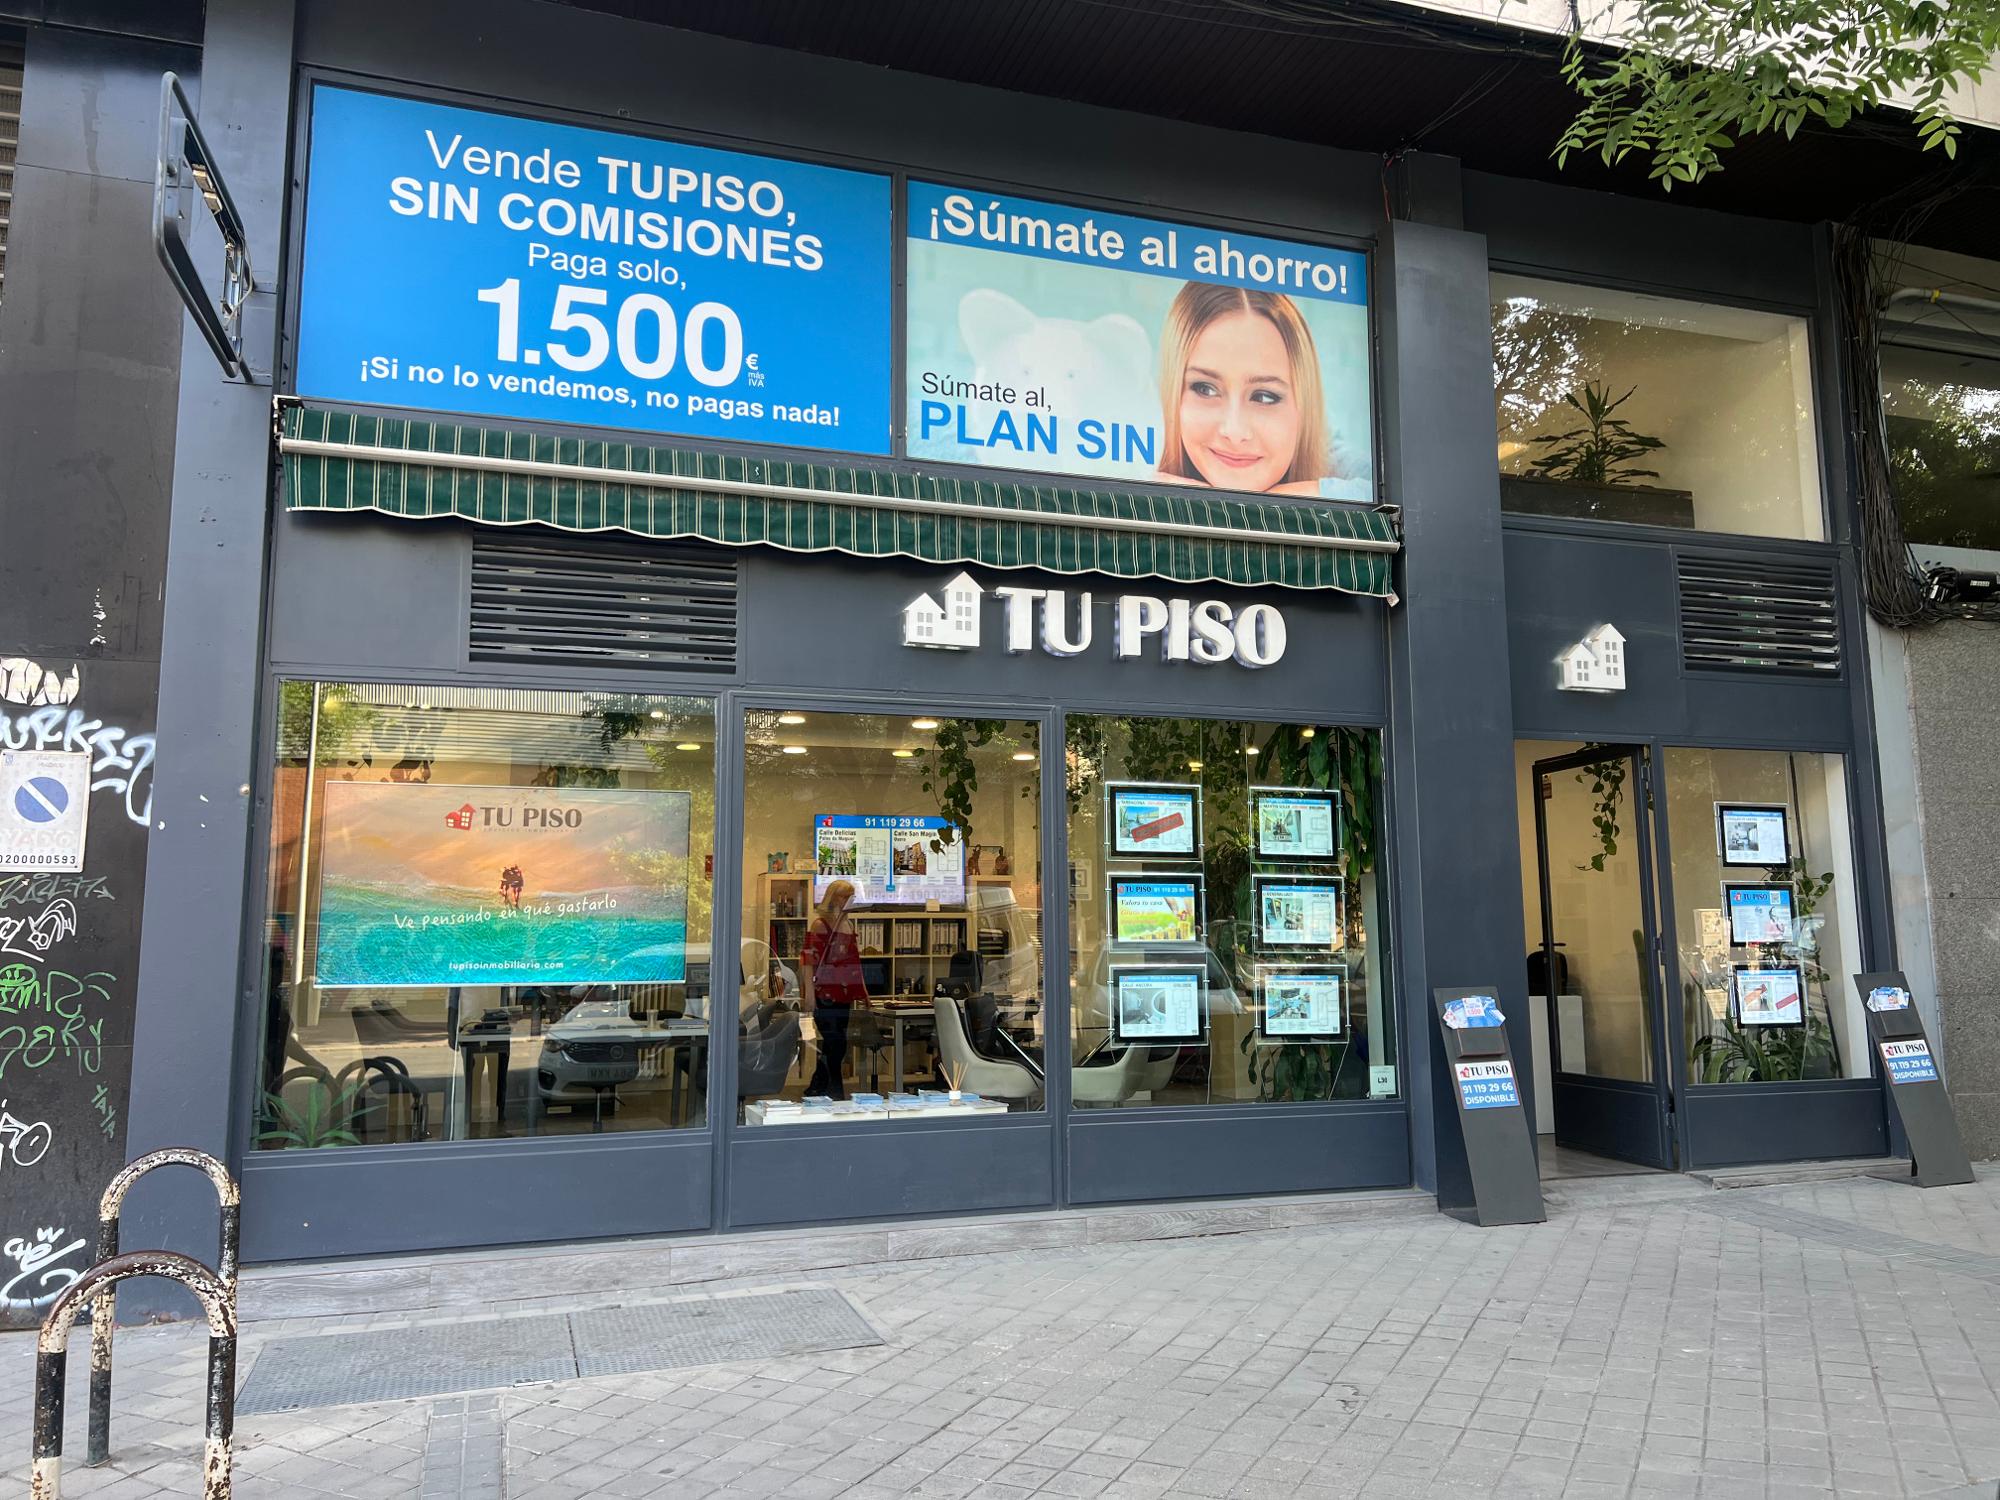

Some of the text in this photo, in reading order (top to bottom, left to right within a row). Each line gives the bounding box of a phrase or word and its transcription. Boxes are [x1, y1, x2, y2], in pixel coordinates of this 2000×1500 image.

[425, 130, 796, 225] Vende TUPISO,
[389, 176, 823, 271] SIN COMISIONES
[931, 195, 1348, 294] ¡Súmate al ahorro!
[528, 243, 686, 290] Paga solo,
[477, 277, 743, 387] 1.500
[361, 356, 839, 426] ¡Si no lo vendemos, no pagas nada!
[749, 379, 765, 387] IVA
[922, 372, 1052, 412] Súmate al,
[921, 400, 1155, 464] PLAN SIN
[995, 586, 1287, 669] TU PISO
[480, 807, 582, 828] TU PISO
[865, 817, 925, 828] 91 119 29 66
[394, 896, 617, 930] Ve pensando en qué gastarlo
[449, 960, 564, 971] tupisoinmobiliaria.com
[1893, 1044, 1926, 1054] TU PISO
[1470, 1065, 1509, 1076] TU PISO
[1893, 1069, 1935, 1079] DISPONIBLE
[1911, 1060, 1920, 1068] 29
[1462, 1082, 1513, 1094] 91 119 29 66
[1465, 1093, 1517, 1105] DISPONIBLE
